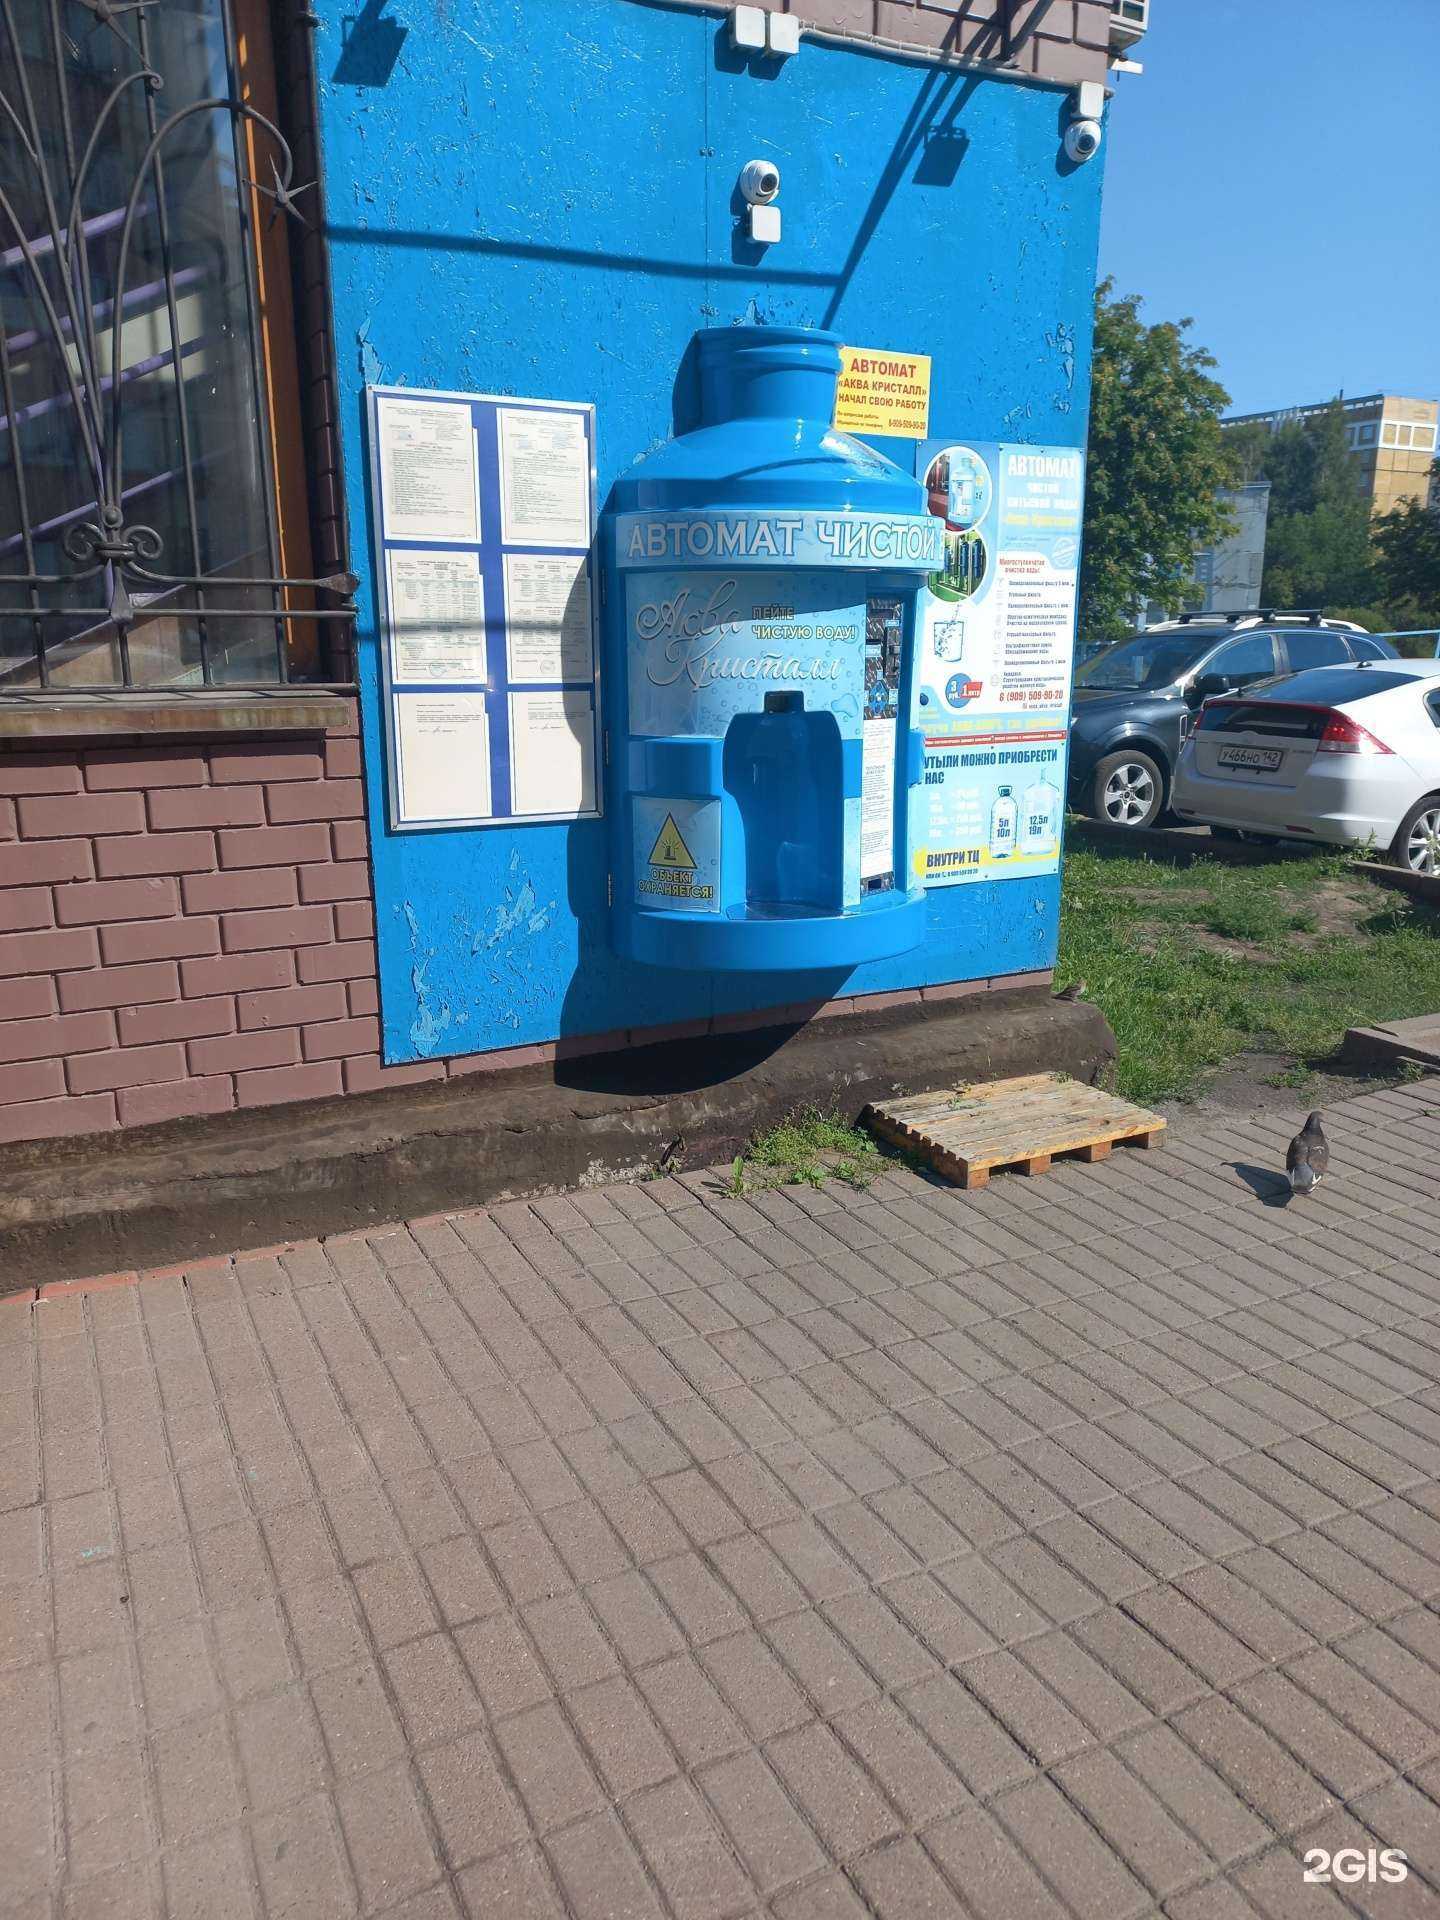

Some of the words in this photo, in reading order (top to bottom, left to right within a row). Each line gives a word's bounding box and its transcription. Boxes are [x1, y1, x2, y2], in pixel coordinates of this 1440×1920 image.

[850, 358, 917, 378] АВТОМАТ
[871, 381, 927, 396] КРИСТАЛЛ»
[838, 393, 867, 404] НАЧАЛ
[868, 396, 894, 407] СВОЮ
[895, 399, 927, 411] РАБОТУ
[1007, 454, 1078, 478] АВТОМАТ
[627, 519, 802, 558] АВТОМАТ
[816, 518, 936, 560] ЧИСТОЙ
[752, 604, 794, 620] ПЕЙТЕ
[752, 624, 812, 640] ЧИСТУЮ
[815, 625, 856, 641] ВОДУ!
[950, 680, 957, 692] 3
[1006, 691, 1027, 702] (909)
[924, 754, 959, 769] УТЫЛИ
[961, 752, 996, 767] МОЖНО
[998, 749, 1058, 765] ПРИОБРЕСТИ
[925, 771, 945, 785] НАС
[998, 818, 1009, 828] 5л
[1029, 826, 1042, 835] 19л
[997, 828, 1010, 838] 10л
[926, 851, 965, 868] ВНУТРИ
[967, 849, 980, 864] ТЦ
[651, 868, 694, 885] ОБЪЕКТ
[638, 880, 714, 899] ОХРАНЯЕТСЯ!
